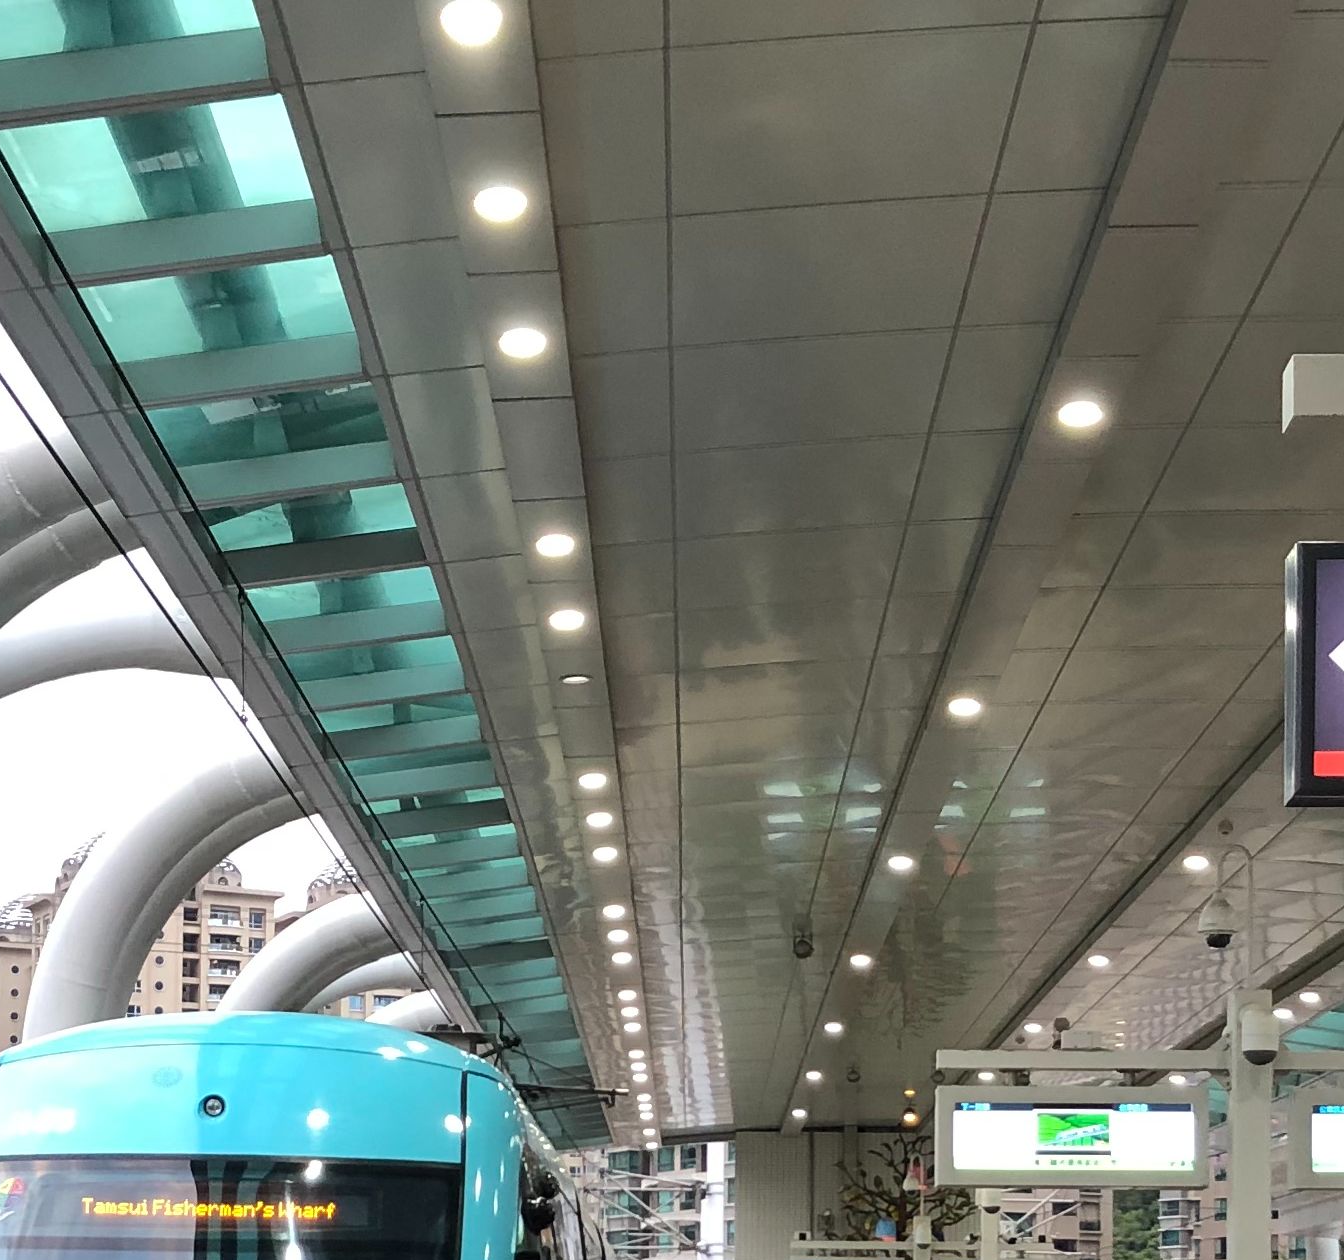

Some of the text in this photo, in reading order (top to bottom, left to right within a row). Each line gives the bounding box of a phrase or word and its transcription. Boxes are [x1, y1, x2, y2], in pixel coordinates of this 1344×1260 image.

[81, 1197, 337, 1220] Tamsui Fisherman's Wharf
